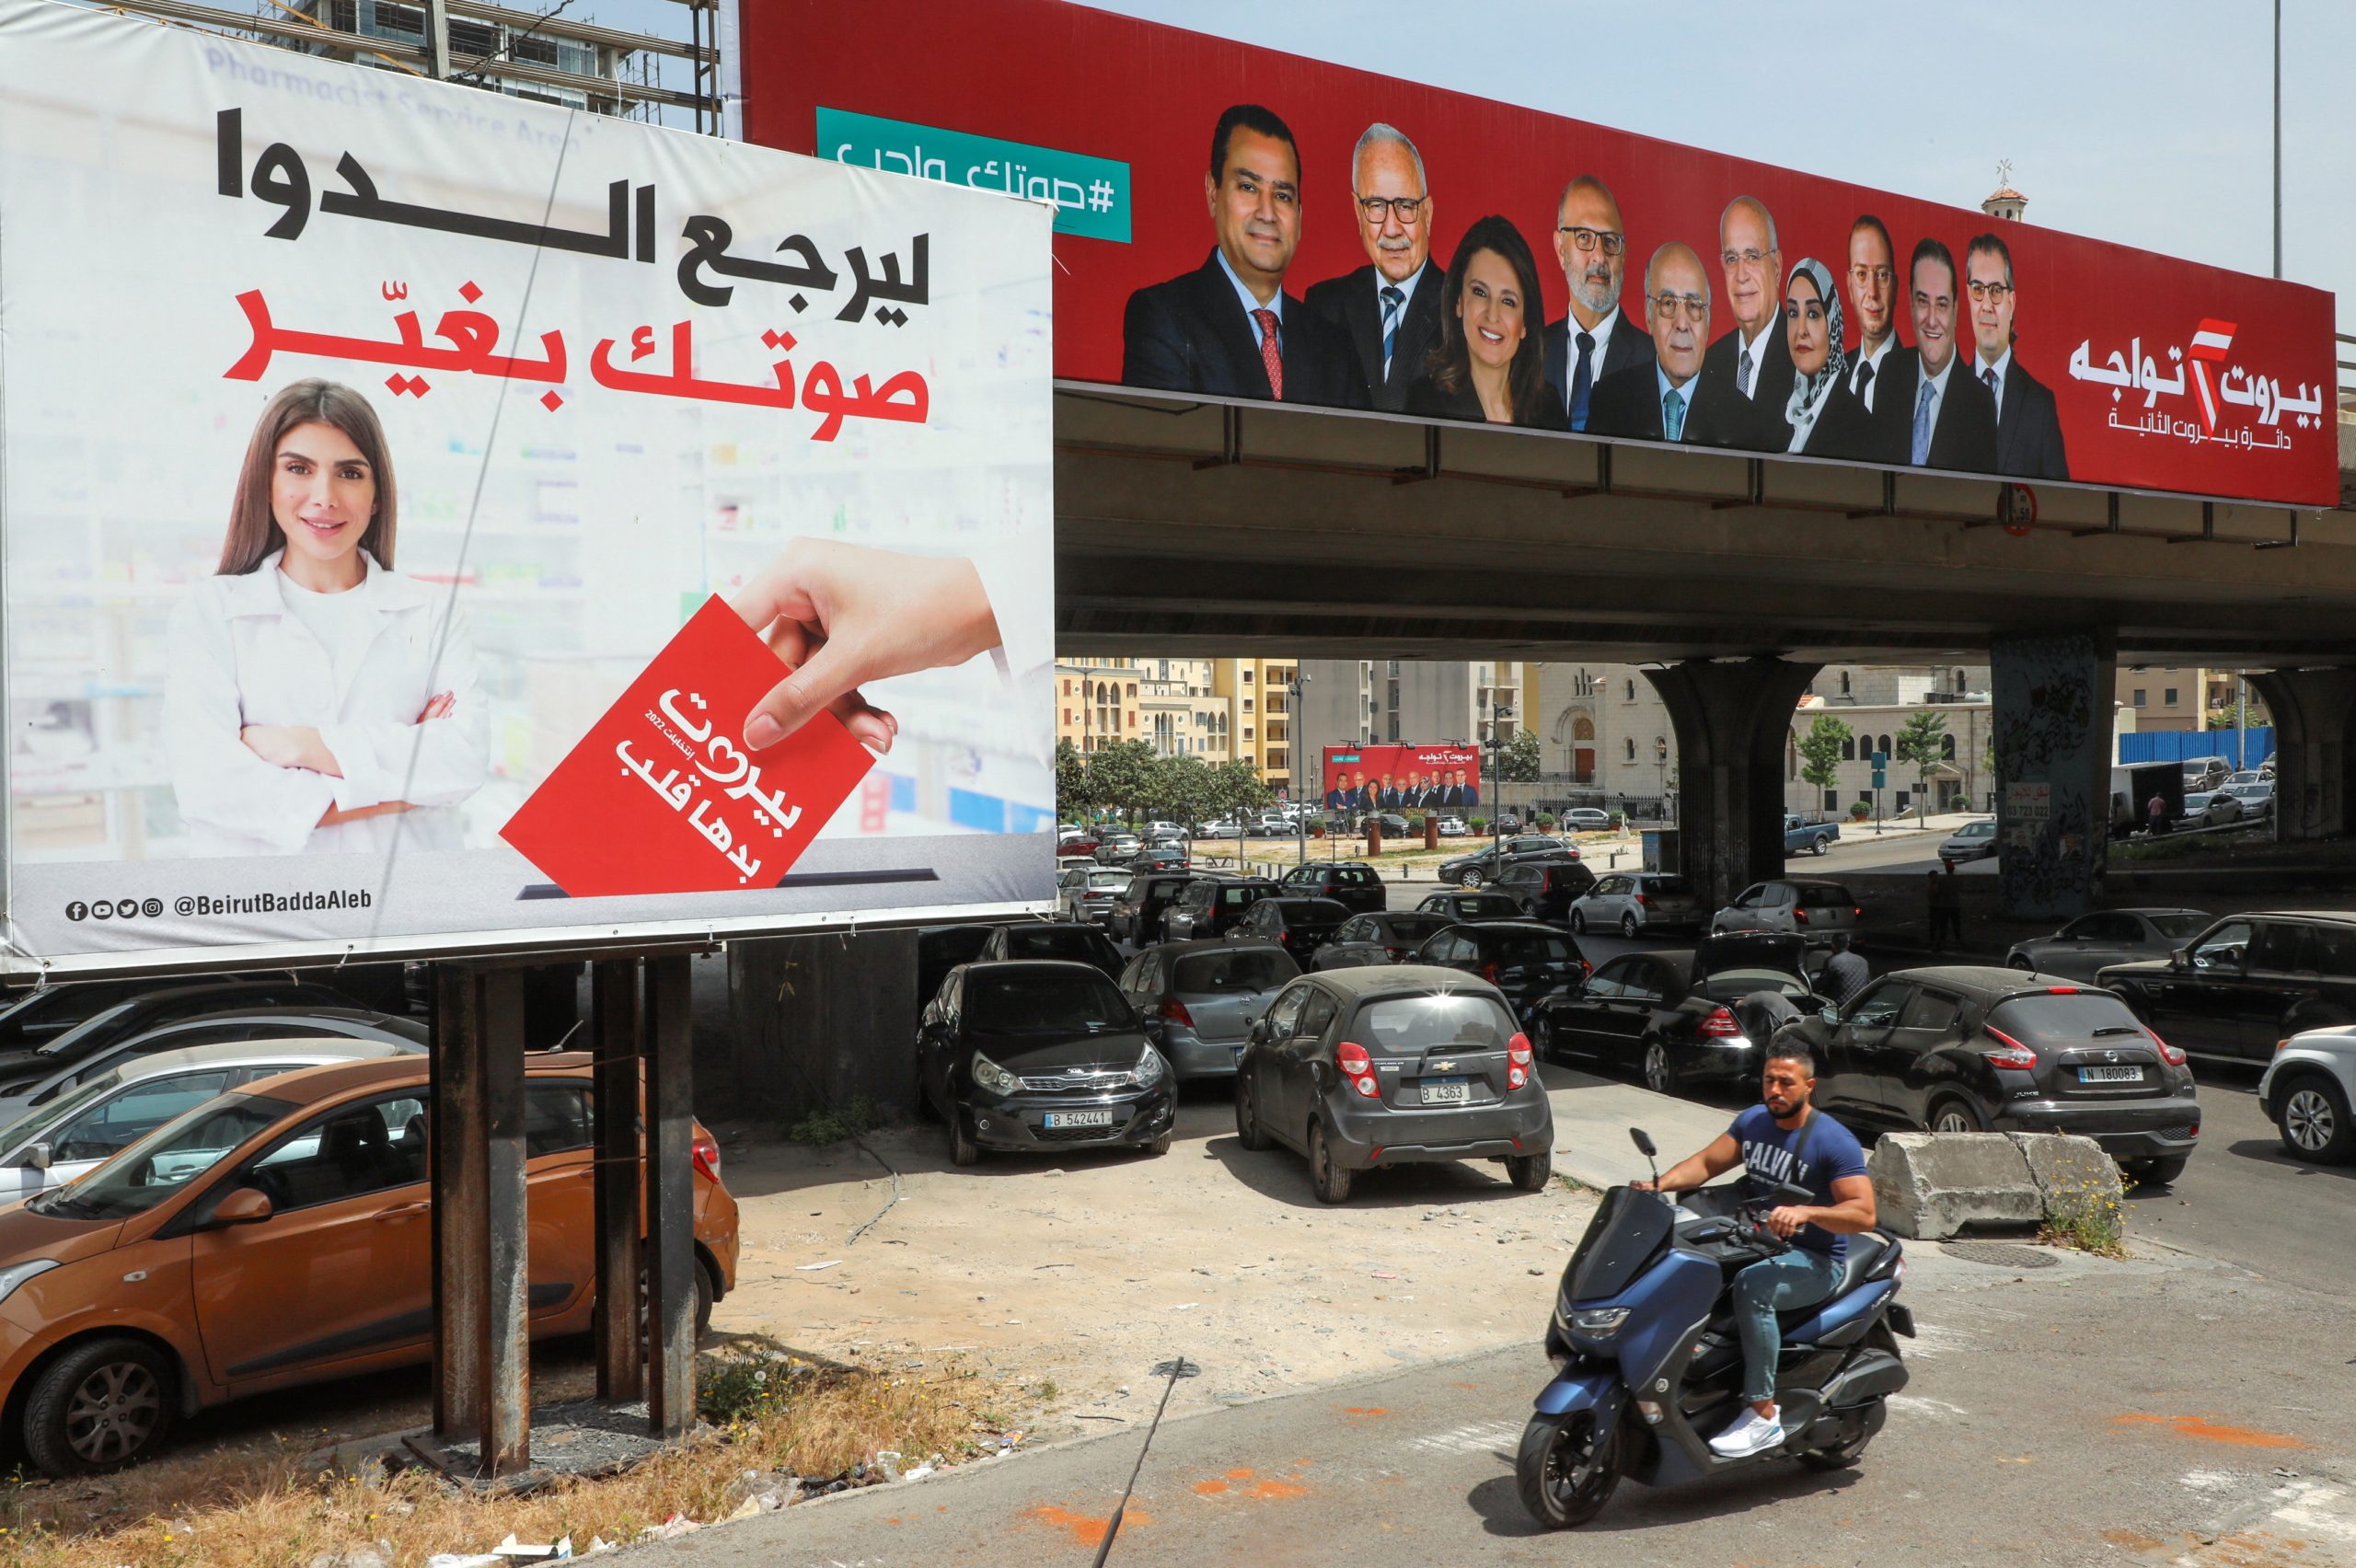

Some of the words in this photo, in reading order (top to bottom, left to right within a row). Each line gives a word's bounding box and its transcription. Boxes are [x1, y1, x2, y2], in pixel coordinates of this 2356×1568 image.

[217, 107, 655, 264] الدوا
[677, 214, 929, 329] ليرجع
[590, 320, 929, 442] صوتك
[2068, 336, 2186, 409] تواجه
[2220, 364, 2322, 430] بيروت
[2108, 407, 2171, 437] الثانية
[2173, 420, 2238, 449] بيروت
[2240, 425, 2292, 451] دائرة
[644, 709, 666, 731] 2022
[616, 740, 701, 812] قلب
[659, 688, 803, 838] بيروت
[2019, 805, 2033, 816] 723
[687, 799, 762, 884] بدها
[174, 889, 371, 917] @BeirutBaddaAleb
[2086, 1068, 2095, 1080] N
[2100, 1067, 2137, 1080] 180083
[1422, 1088, 1430, 1101] B
[1437, 1087, 1463, 1099] 4363
[1054, 1114, 1061, 1126] B
[1067, 1113, 1104, 1125] 542441
